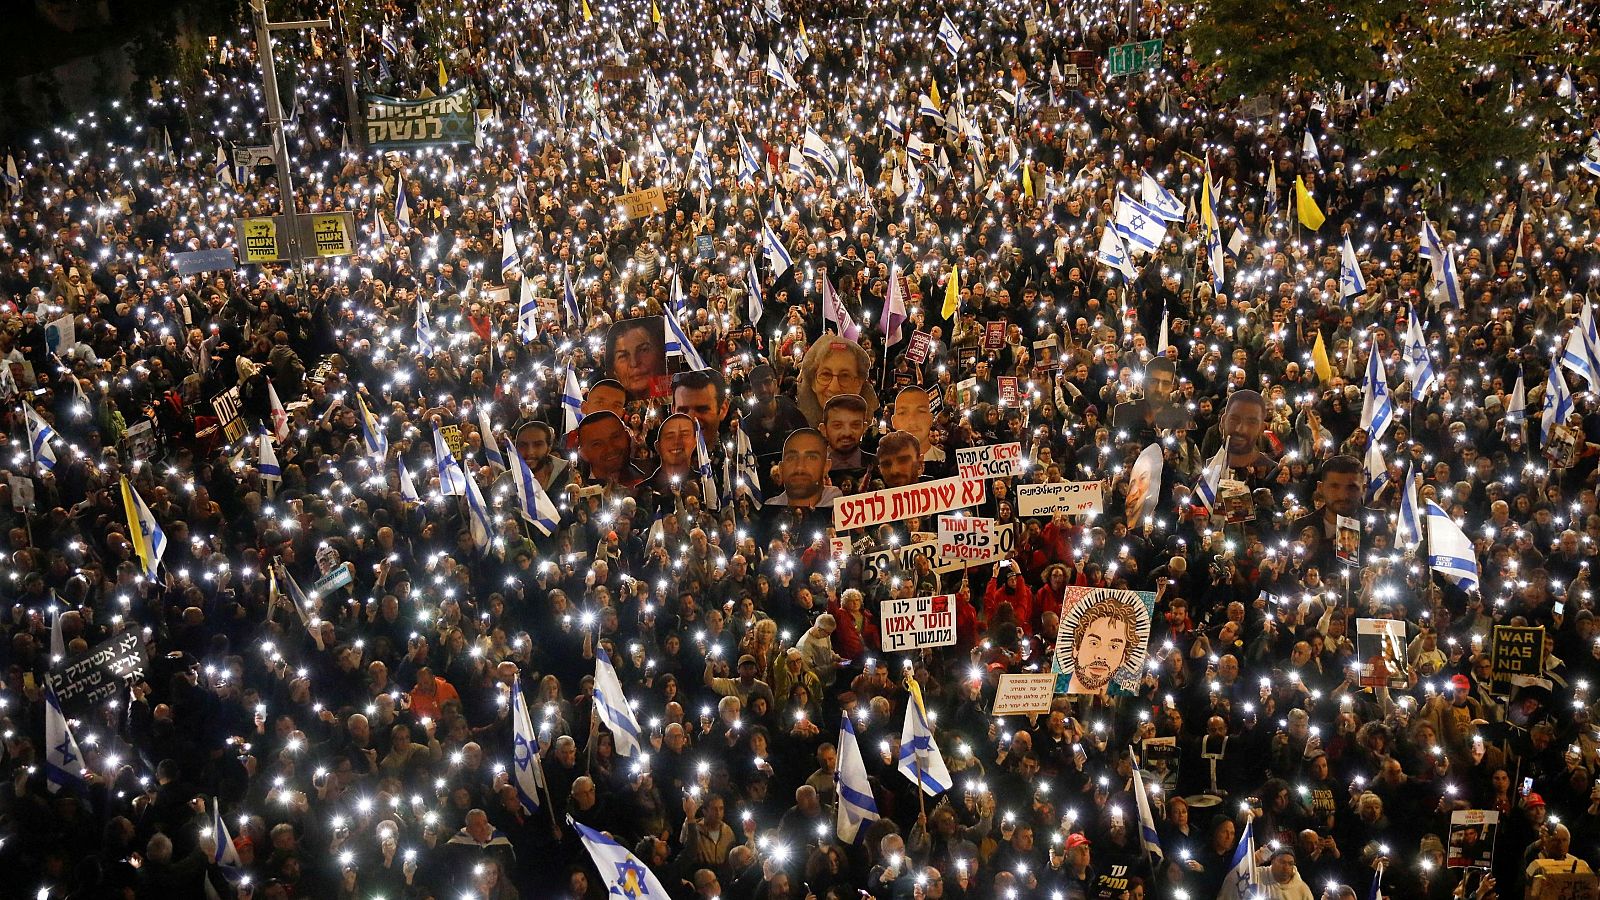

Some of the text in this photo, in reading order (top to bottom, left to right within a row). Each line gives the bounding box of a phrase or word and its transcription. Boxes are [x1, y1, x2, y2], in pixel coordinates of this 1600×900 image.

[367, 116, 443, 143] לנשק
[647, 191, 658, 200] עם
[248, 238, 273, 247] אשם
[317, 233, 342, 242] אשם
[249, 248, 275, 256] במחדל
[957, 444, 1020, 465] ישראל לא תהיה
[891, 483, 956, 519] שוכחות
[1078, 502, 1093, 510] דמי
[840, 493, 885, 527] לרגע
[942, 519, 988, 533] גם מחר
[954, 532, 990, 546] כולם
[942, 544, 990, 559] בירושלים
[893, 600, 930, 614] יש לנו
[886, 612, 952, 635] חוסר אמון
[119, 633, 138, 654] לא
[889, 629, 952, 649] מתמשך בך
[1499, 631, 1535, 643] WAR
[1499, 646, 1532, 658] HAS
[65, 647, 116, 683] אשתוק
[1499, 659, 1521, 670] NO
[57, 652, 141, 702] ארצי שינתה
[87, 668, 144, 704] את פניה
[1111, 865, 1128, 877] עד
[1098, 875, 1128, 890] מתי?
